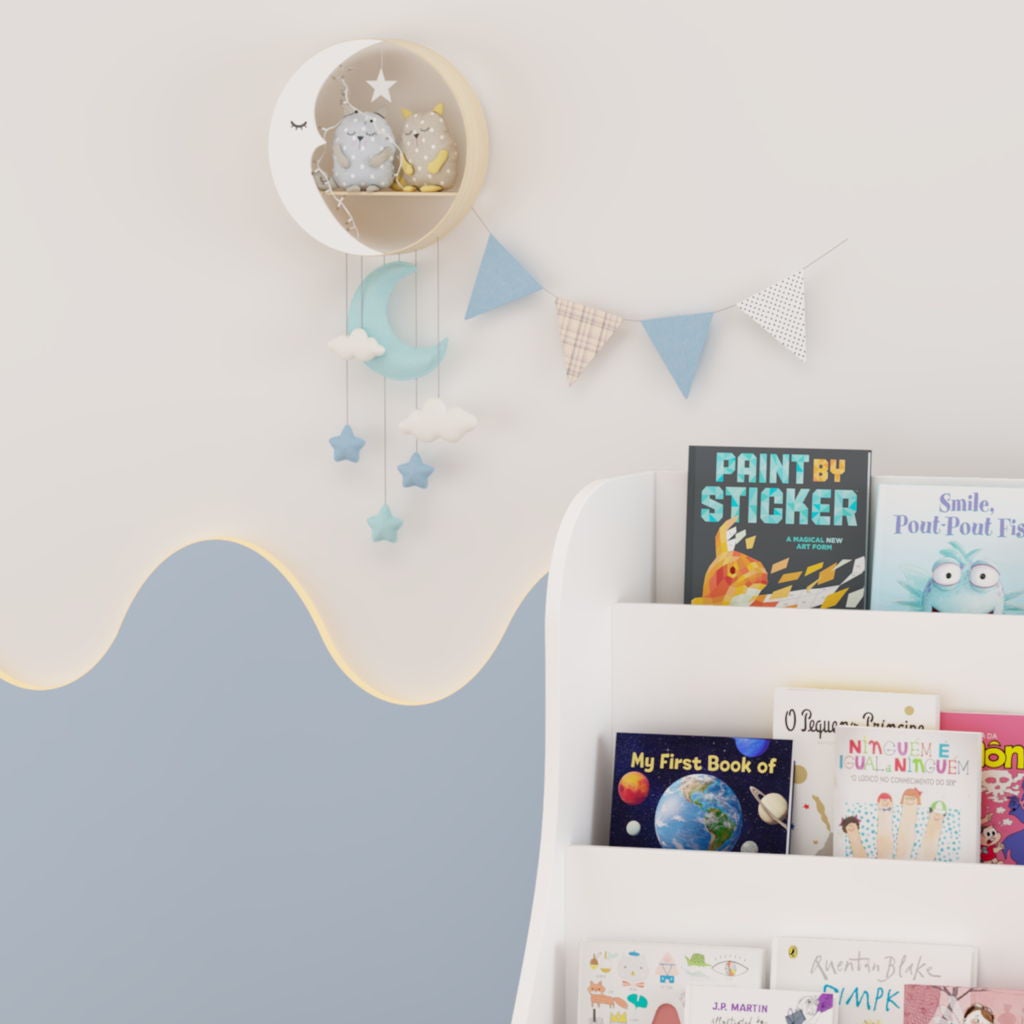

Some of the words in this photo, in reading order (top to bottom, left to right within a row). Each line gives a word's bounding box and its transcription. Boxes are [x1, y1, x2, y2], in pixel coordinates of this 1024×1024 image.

[716, 452, 809, 484] PAINT
[813, 458, 846, 483] BY
[700, 486, 858, 526] STICKER
[939, 492, 994, 514] Smile,
[893, 514, 992, 536] Pout-Pout
[785, 709, 796, 732] O
[631, 752, 655, 773] My
[660, 754, 702, 771] First
[707, 755, 751, 773] Book
[757, 758, 777, 774] of
[839, 755, 884, 772] IGUAL
[877, 954, 942, 982] Blake
[712, 1002, 727, 1011] J.P.
[731, 1003, 768, 1013] MARTIN
[823, 984, 900, 1011] IMPK
